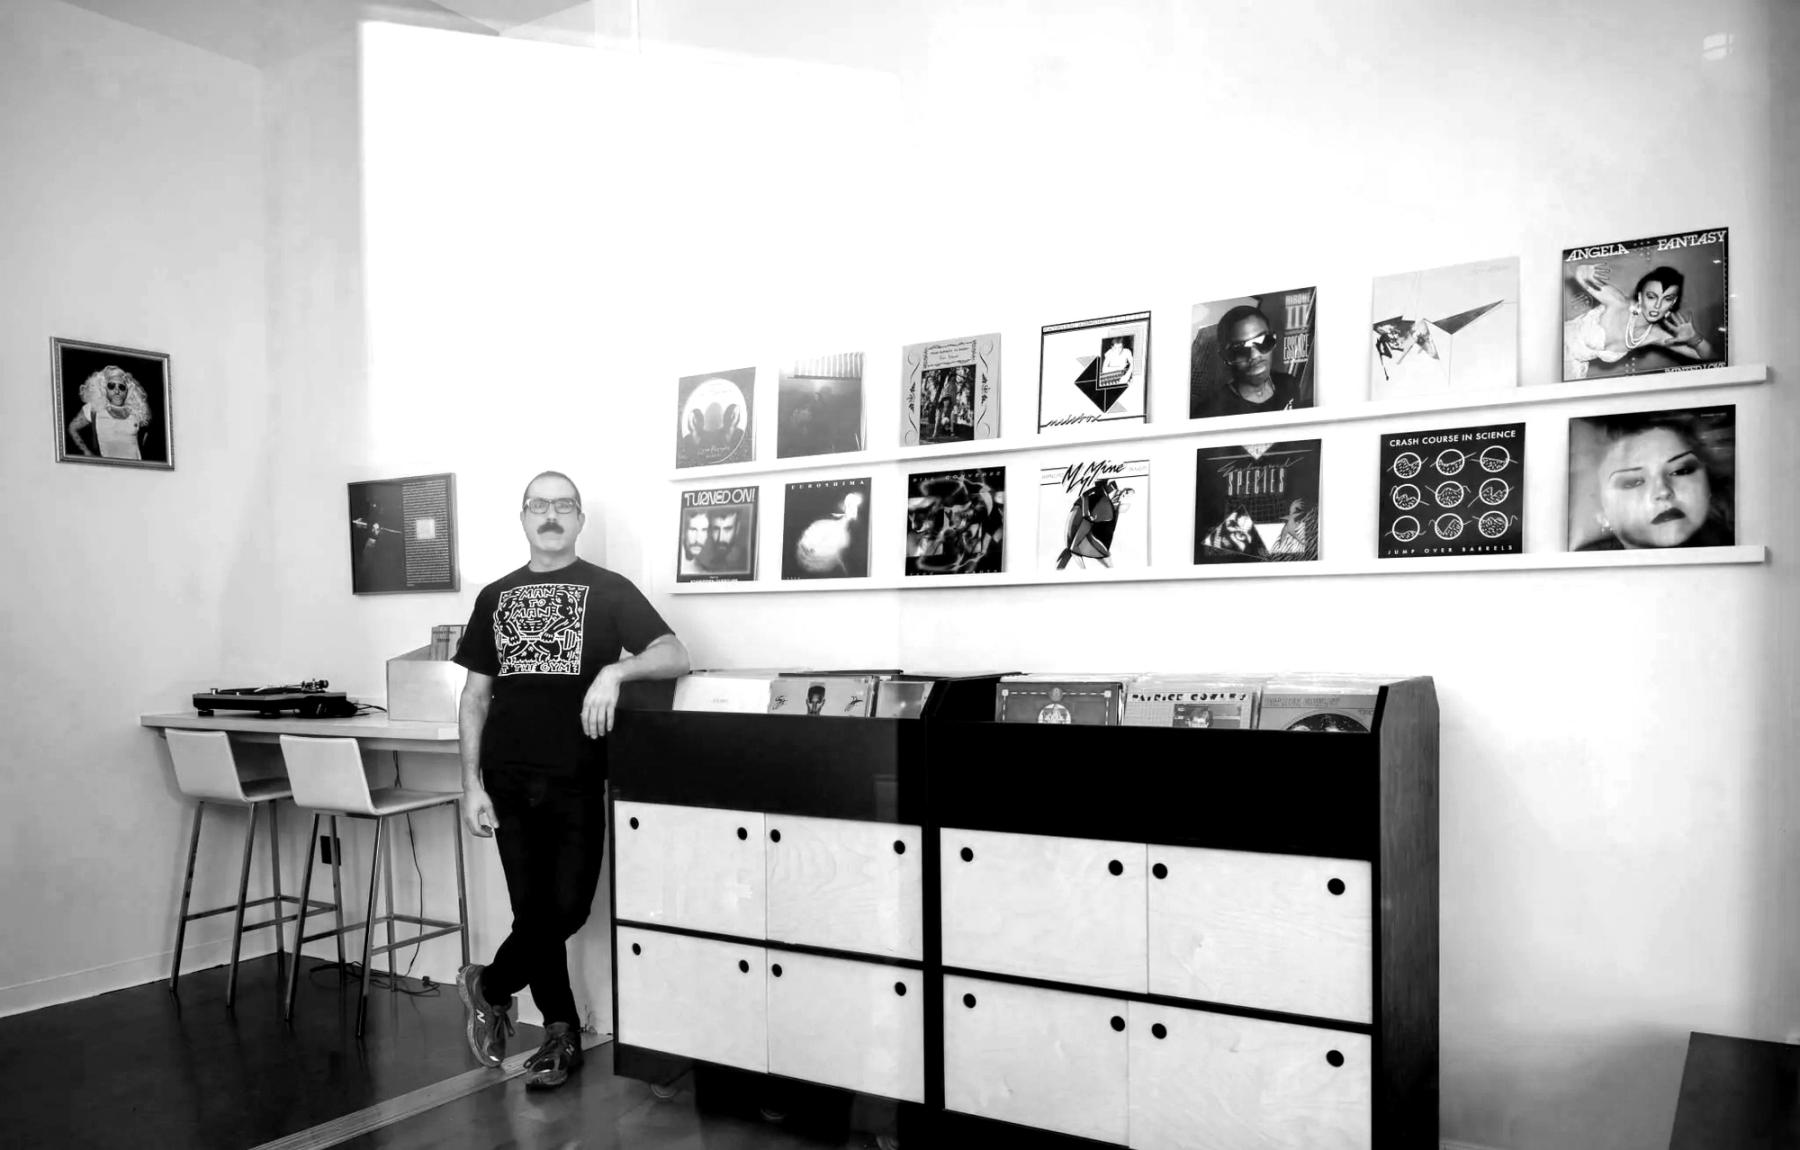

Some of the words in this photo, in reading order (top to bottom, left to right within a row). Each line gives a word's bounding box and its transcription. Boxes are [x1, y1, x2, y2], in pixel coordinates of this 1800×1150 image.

[1565, 244, 1629, 261] ANGELA
[1657, 230, 1727, 251] FANTASY
[1389, 438, 1419, 447] CRASH
[1422, 434, 1459, 444] COURSE
[1462, 433, 1473, 441] IN
[1476, 430, 1516, 440] SCIENCE
[1061, 462, 1091, 496] My
[1083, 459, 1126, 486] Mine
[1228, 468, 1285, 496] SPECIES
[684, 490, 731, 506] TURNED
[1424, 546, 1452, 554] OVER
[1462, 544, 1513, 553] BARRELS
[519, 588, 555, 600] MAN
[529, 599, 546, 608] TO
[512, 606, 551, 619] MAN
[540, 662, 571, 673] GYM
